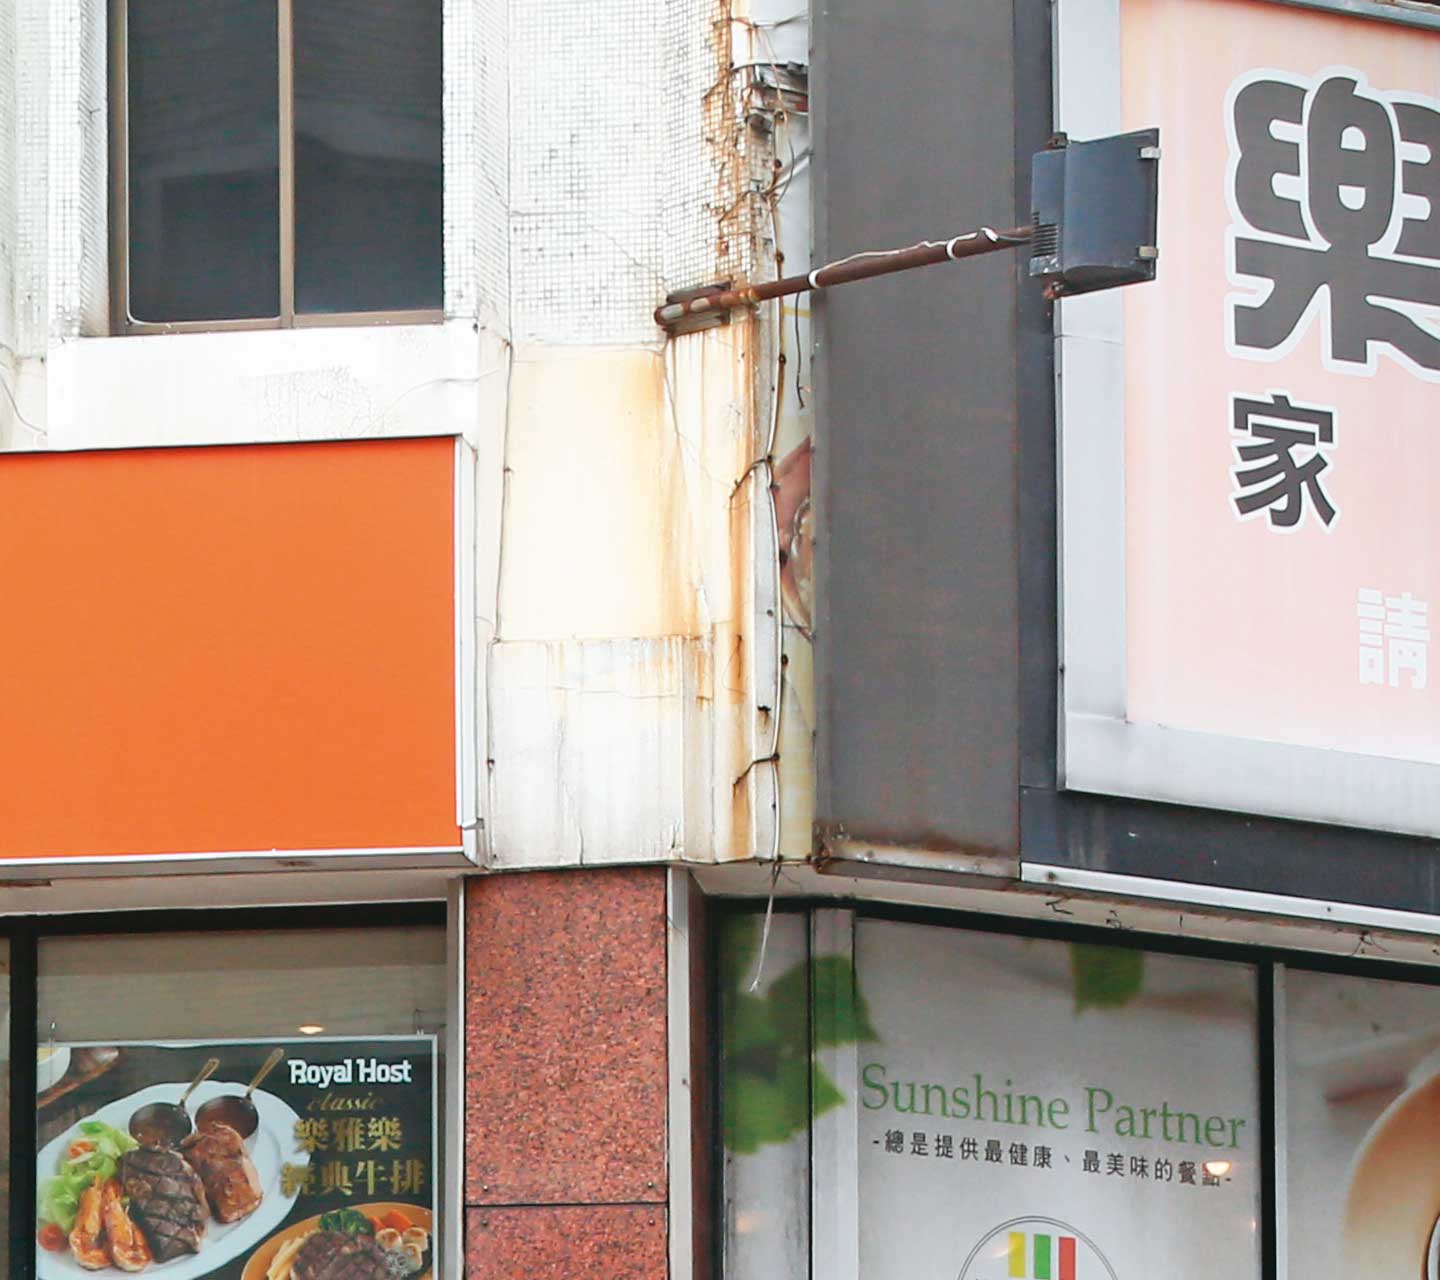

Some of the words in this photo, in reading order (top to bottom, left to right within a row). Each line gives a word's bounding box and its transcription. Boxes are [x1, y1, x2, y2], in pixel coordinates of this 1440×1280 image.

[1230, 392, 1340, 530] 家
[1357, 590, 1430, 688] 請
[288, 1059, 352, 1088] Royal
[356, 1058, 412, 1083] Host
[862, 1063, 1070, 1130] Sunshine
[1084, 1087, 1248, 1150] Partner
[294, 1117, 402, 1152] 樂雅樂
